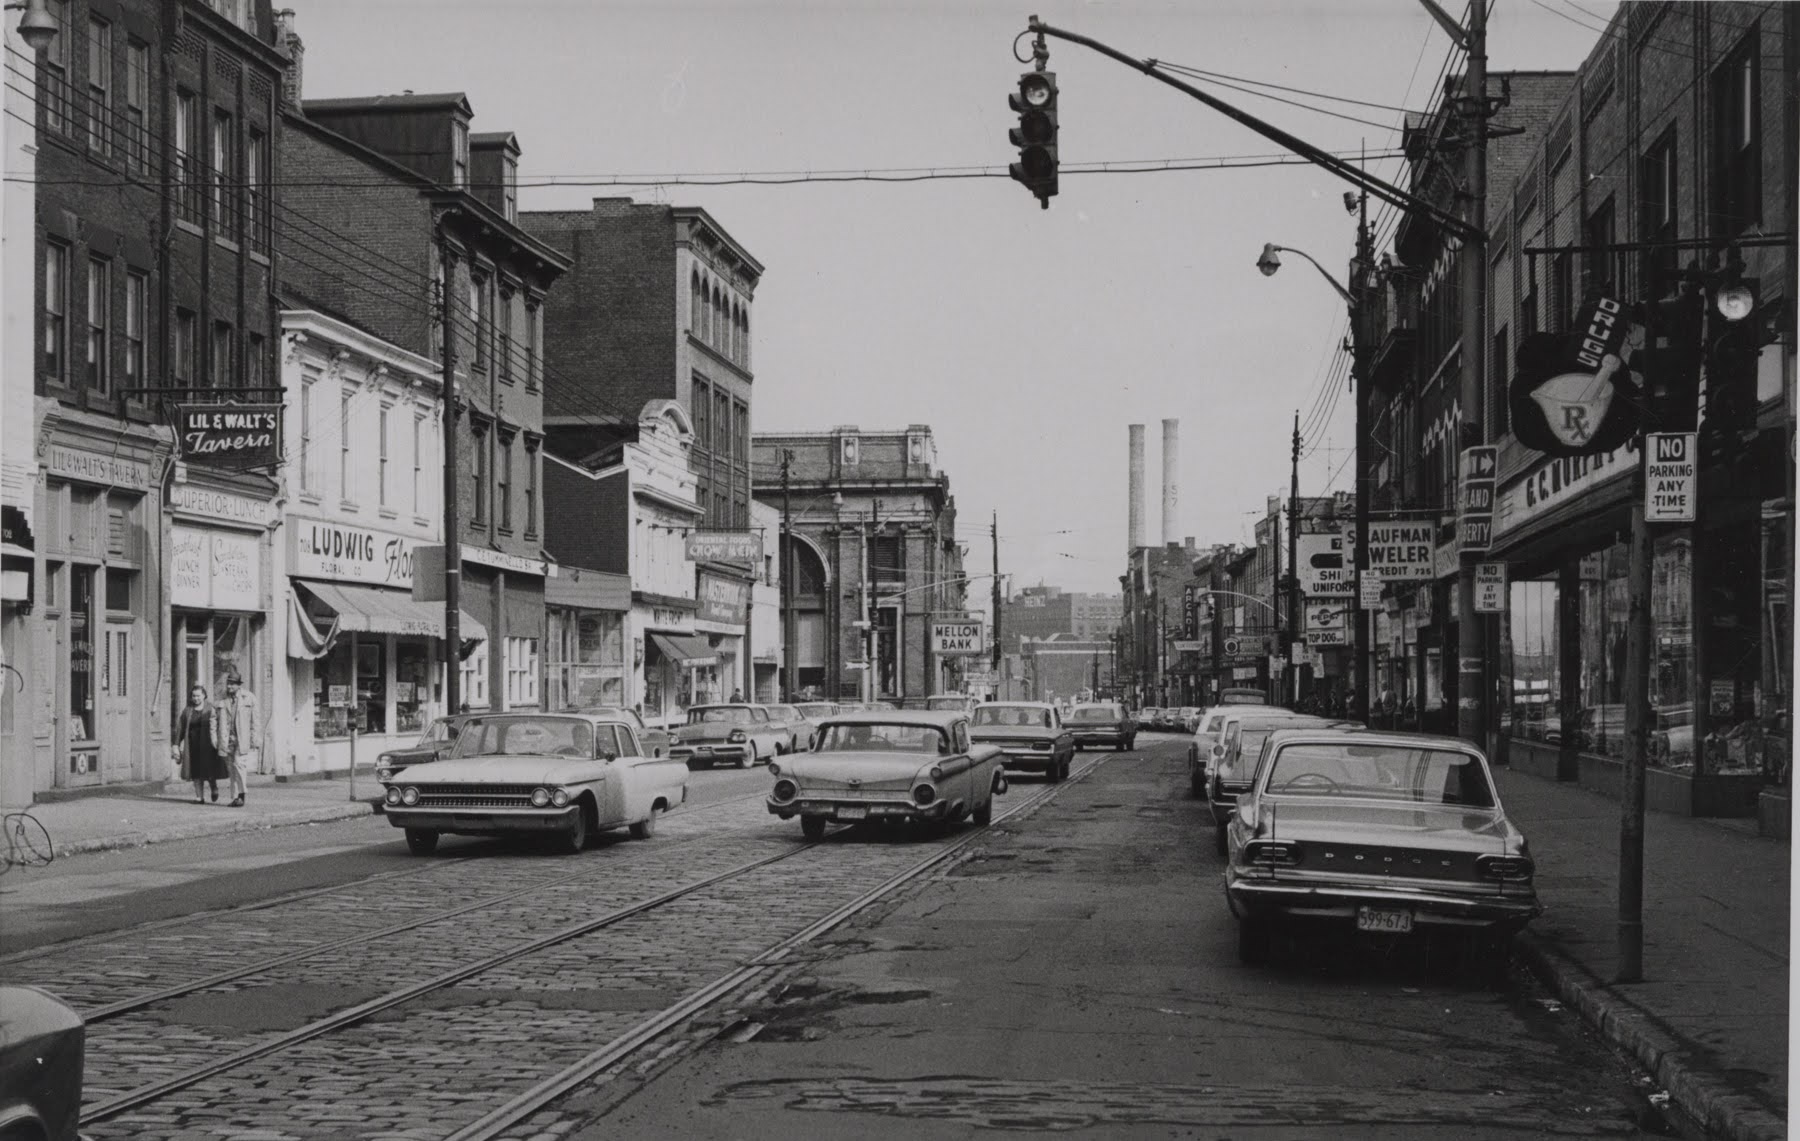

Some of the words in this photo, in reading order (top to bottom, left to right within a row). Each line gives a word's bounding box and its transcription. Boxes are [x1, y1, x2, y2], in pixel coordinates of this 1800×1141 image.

[1577, 297, 1621, 368] DRUGS
[189, 413, 210, 429] LIL
[213, 413, 222, 430] &
[224, 413, 276, 430] WALT'S
[185, 431, 273, 454] Tavern
[1659, 438, 1683, 458] NO
[52, 450, 66, 471] LIL
[73, 455, 105, 479] WALT'S
[108, 462, 144, 486] TAVERN
[1649, 464, 1693, 478] PARKING
[1656, 480, 1685, 492] ANY
[177, 488, 229, 515] SUPERIOR
[233, 498, 266, 520] LUNCH
[1656, 494, 1686, 507] TIME
[695, 536, 727, 544] ORIENTAL
[729, 536, 752, 544] FOODS
[1368, 528, 1432, 545] AUFMAN
[312, 525, 374, 562] LUDWIG
[689, 544, 720, 557] CHOW
[321, 562, 345, 576] FLORAL
[1415, 568, 1432, 577] 725
[1482, 565, 1497, 576] NO
[1477, 576, 1503, 584] PARKING
[1024, 594, 1046, 607] HEINZ
[1483, 593, 1497, 601] ANY
[1483, 601, 1497, 609] TIME
[1185, 587, 1193, 640] ARCADIA
[935, 625, 979, 637] MELLON
[1308, 633, 1321, 643] TOP
[1321, 632, 1337, 643] DOG
[941, 638, 973, 650] BANK
[1325, 851, 1452, 867] DODGE
